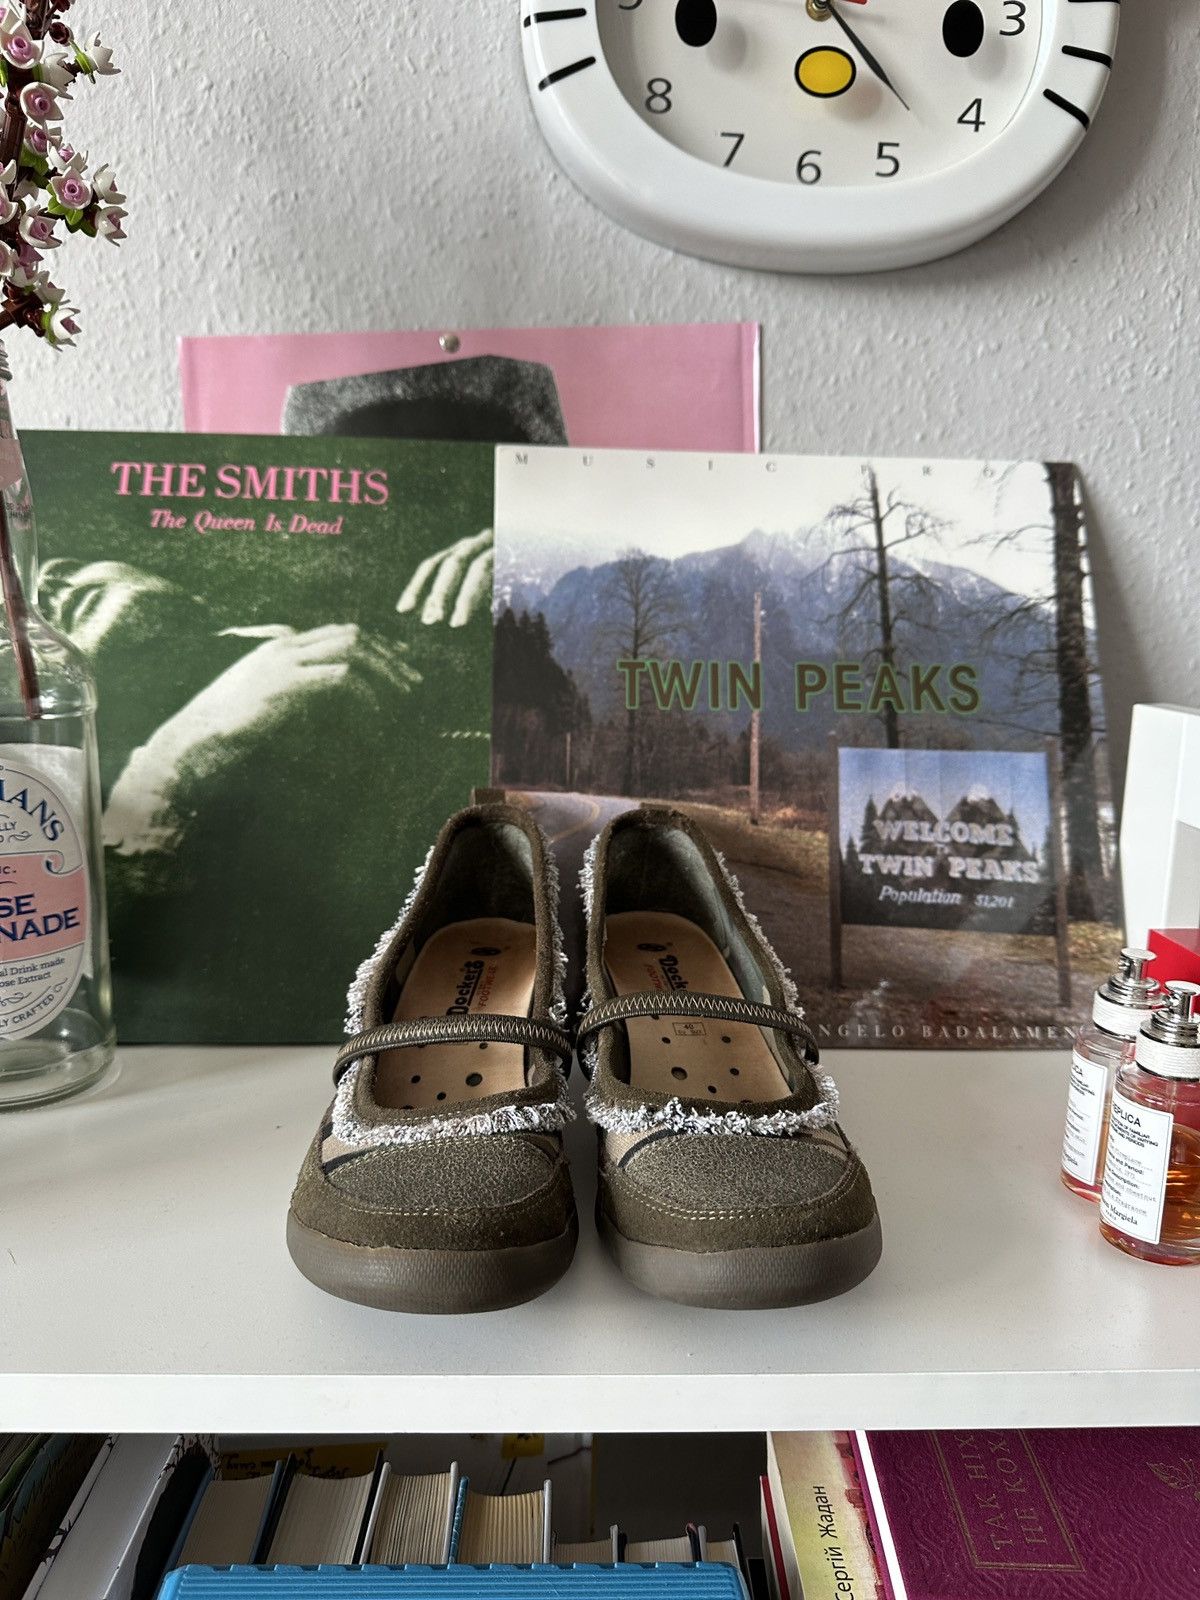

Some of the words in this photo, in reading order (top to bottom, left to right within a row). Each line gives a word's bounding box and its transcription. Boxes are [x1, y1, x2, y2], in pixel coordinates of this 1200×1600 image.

[999, 0, 1026, 37] 3
[644, 78, 673, 115] 8
[956, 98, 986, 133] 4
[720, 132, 745, 168] 7
[796, 149, 822, 185] 6
[875, 141, 900, 178] 5
[110, 460, 207, 498] THE
[214, 463, 390, 506] SMITHS
[149, 508, 188, 530] The
[194, 510, 257, 535] Queen
[264, 512, 283, 533] Is
[288, 513, 345, 536] Dead
[617, 657, 763, 711] TWIN
[795, 660, 981, 715] PEAKS
[872, 818, 1014, 847] WELCOME
[857, 852, 936, 878] TWIN
[948, 855, 1040, 884] PEAKS
[0, 893, 37, 919] SE
[878, 884, 963, 906] Population
[0, 906, 81, 944] NADE
[0, 979, 16, 988] ose
[17, 972, 52, 986] Extract
[10, 964, 39, 977] Drink
[40, 956, 66, 971] made
[658, 954, 689, 992] Dock
[12, 994, 55, 1025] CRAFTED
[819, 1024, 905, 1038] NGELO
[922, 1024, 1077, 1040] BADALAMEN
[986, 1432, 1027, 1493] КОХ
[812, 1485, 838, 1539] Жадан
[974, 1493, 1016, 1550] ТАК
